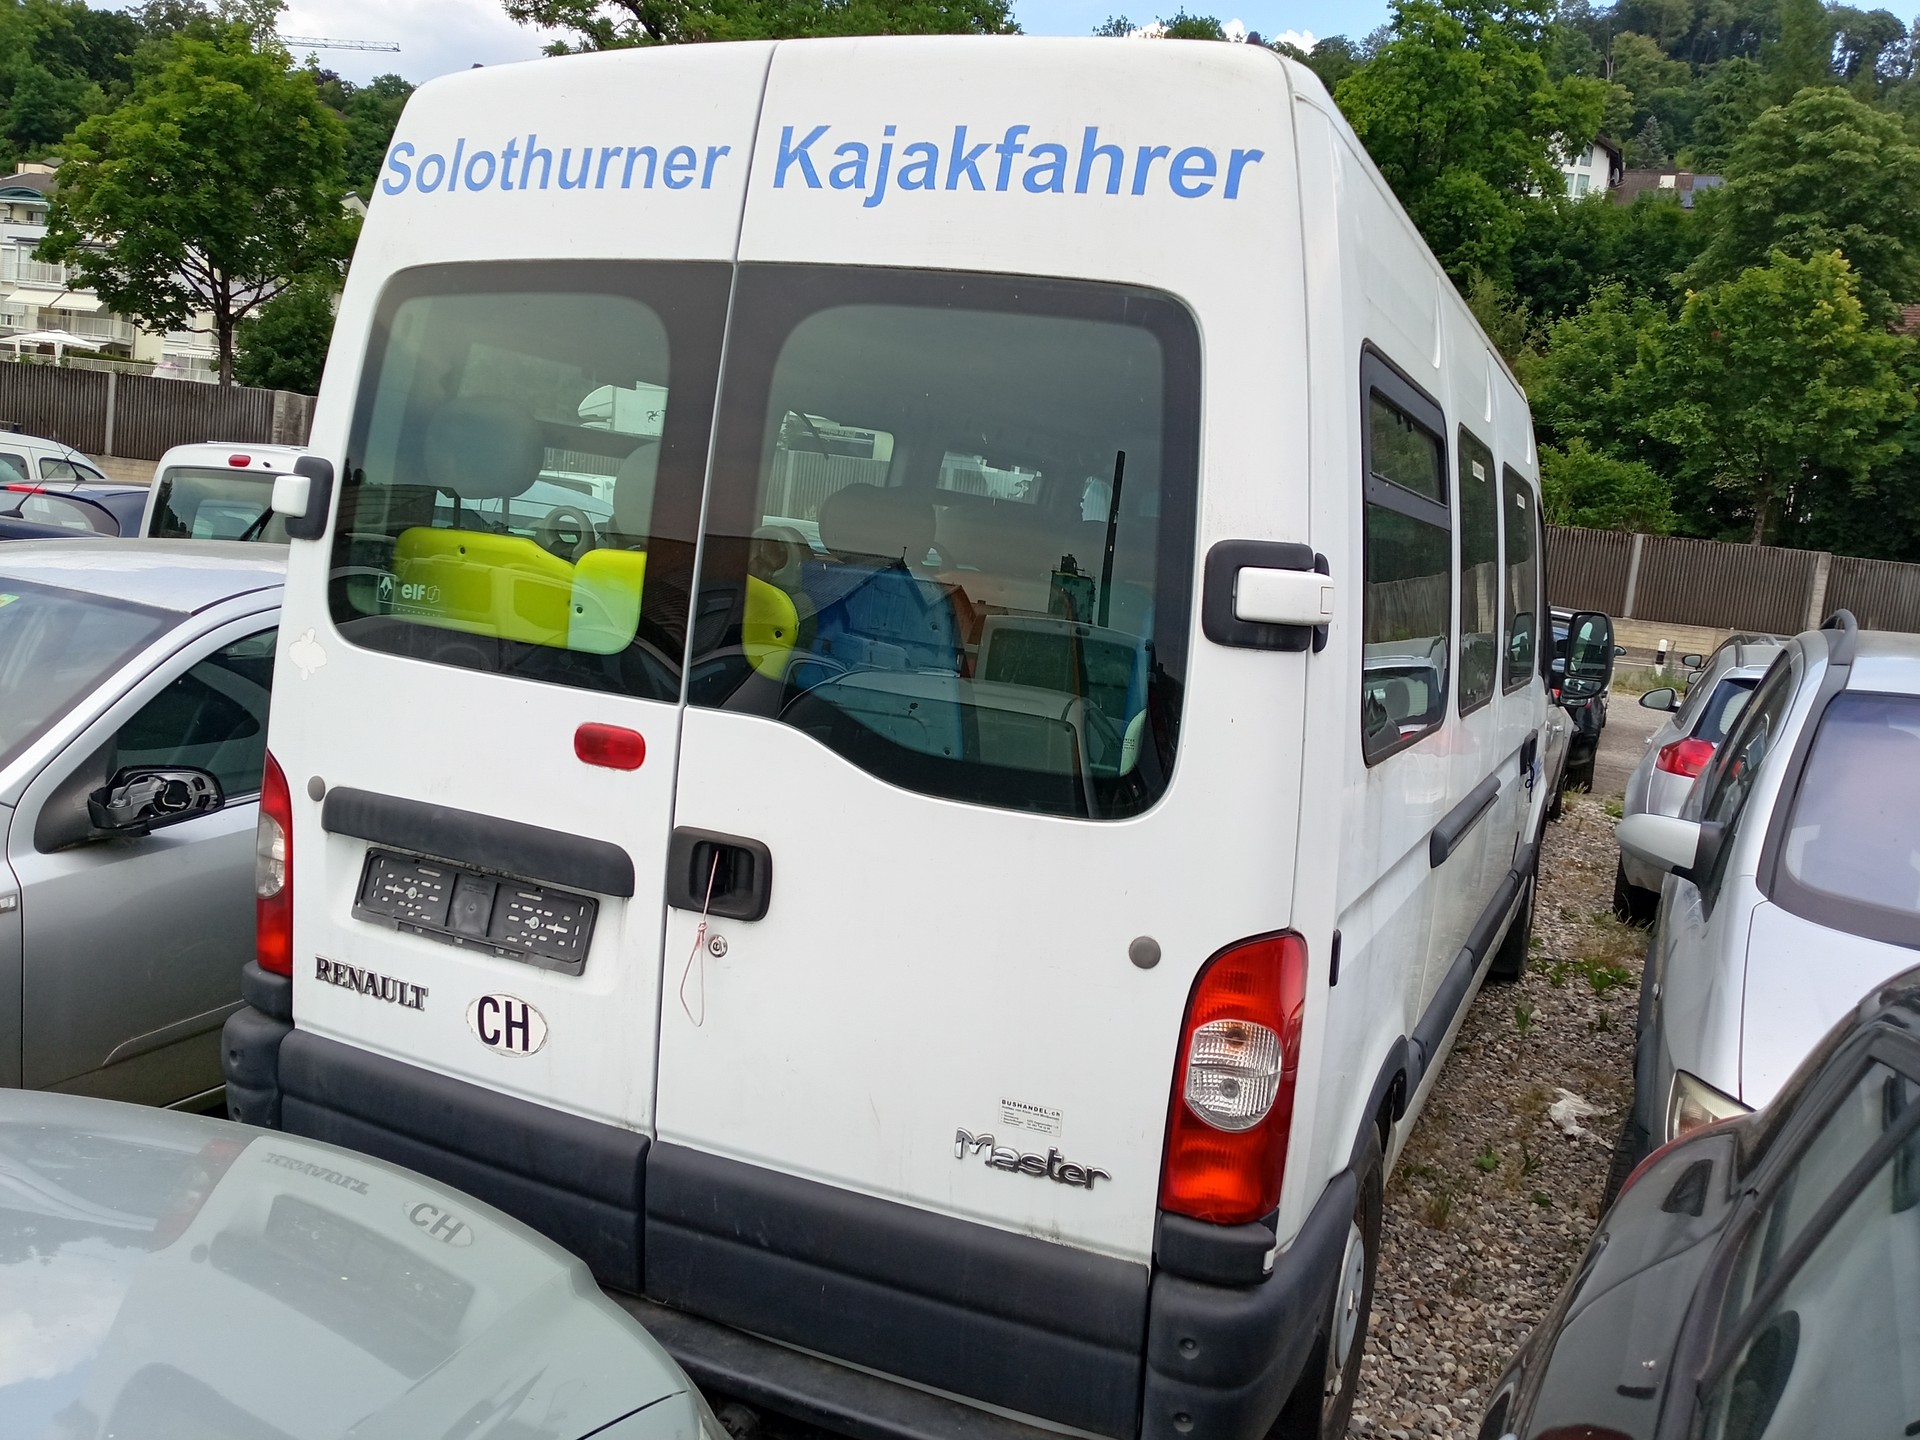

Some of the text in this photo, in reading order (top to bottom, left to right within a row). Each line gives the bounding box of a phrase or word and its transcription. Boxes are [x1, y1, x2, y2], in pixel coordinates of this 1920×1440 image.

[382, 125, 1265, 208] Solothurner Kajakfahrer
[401, 583, 426, 600] elf
[314, 954, 429, 1011] RENAULT
[477, 995, 530, 1052] CH
[1001, 1099, 1061, 1117] BUSHANDEL.ch
[954, 1127, 1112, 1190] Master
